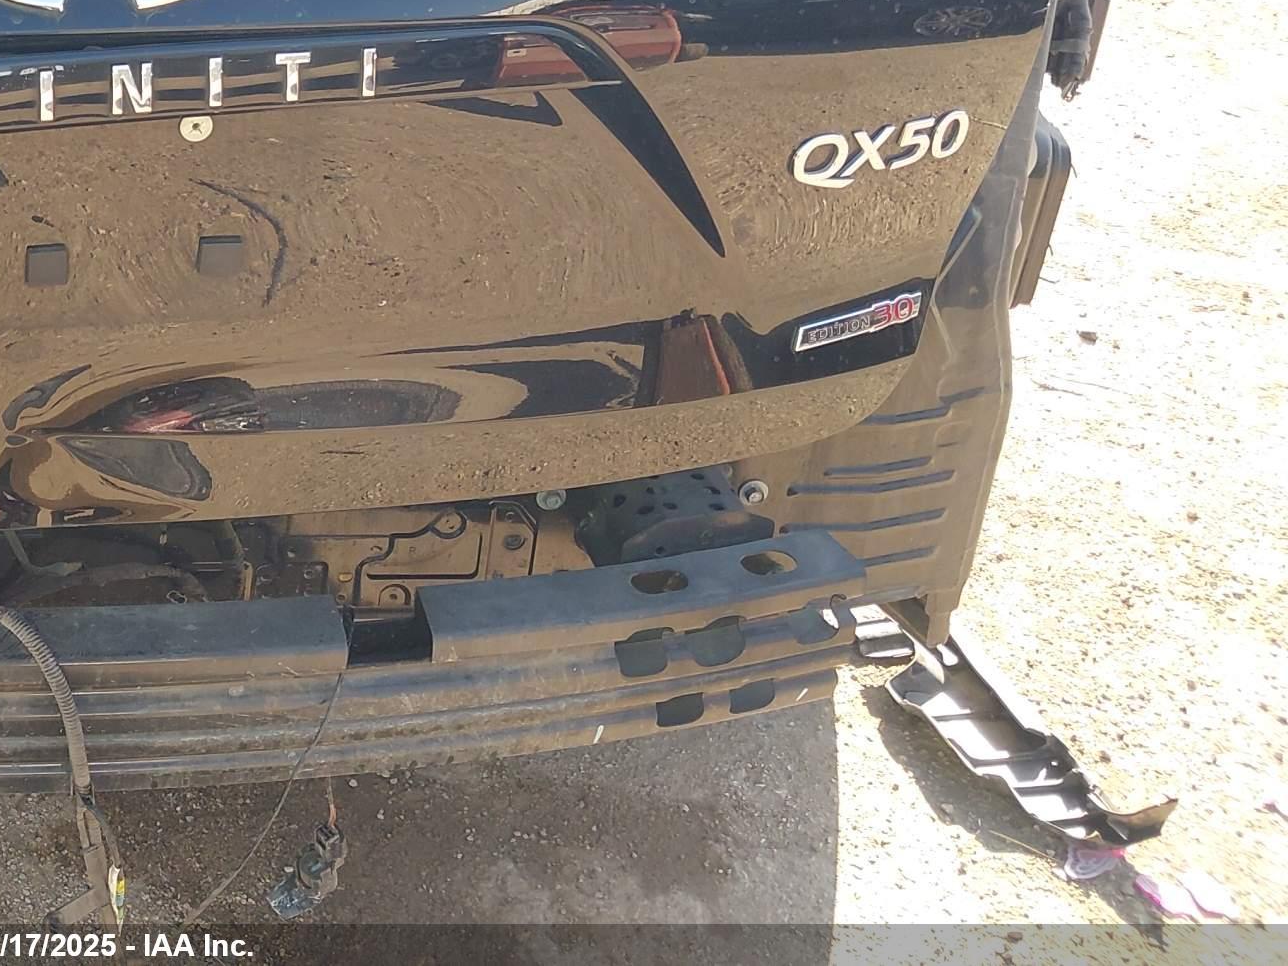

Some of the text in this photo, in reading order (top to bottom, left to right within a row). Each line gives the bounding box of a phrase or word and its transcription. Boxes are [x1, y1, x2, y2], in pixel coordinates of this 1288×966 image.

[790, 109, 970, 189] QX50
[807, 297, 914, 344] EDITION 30
